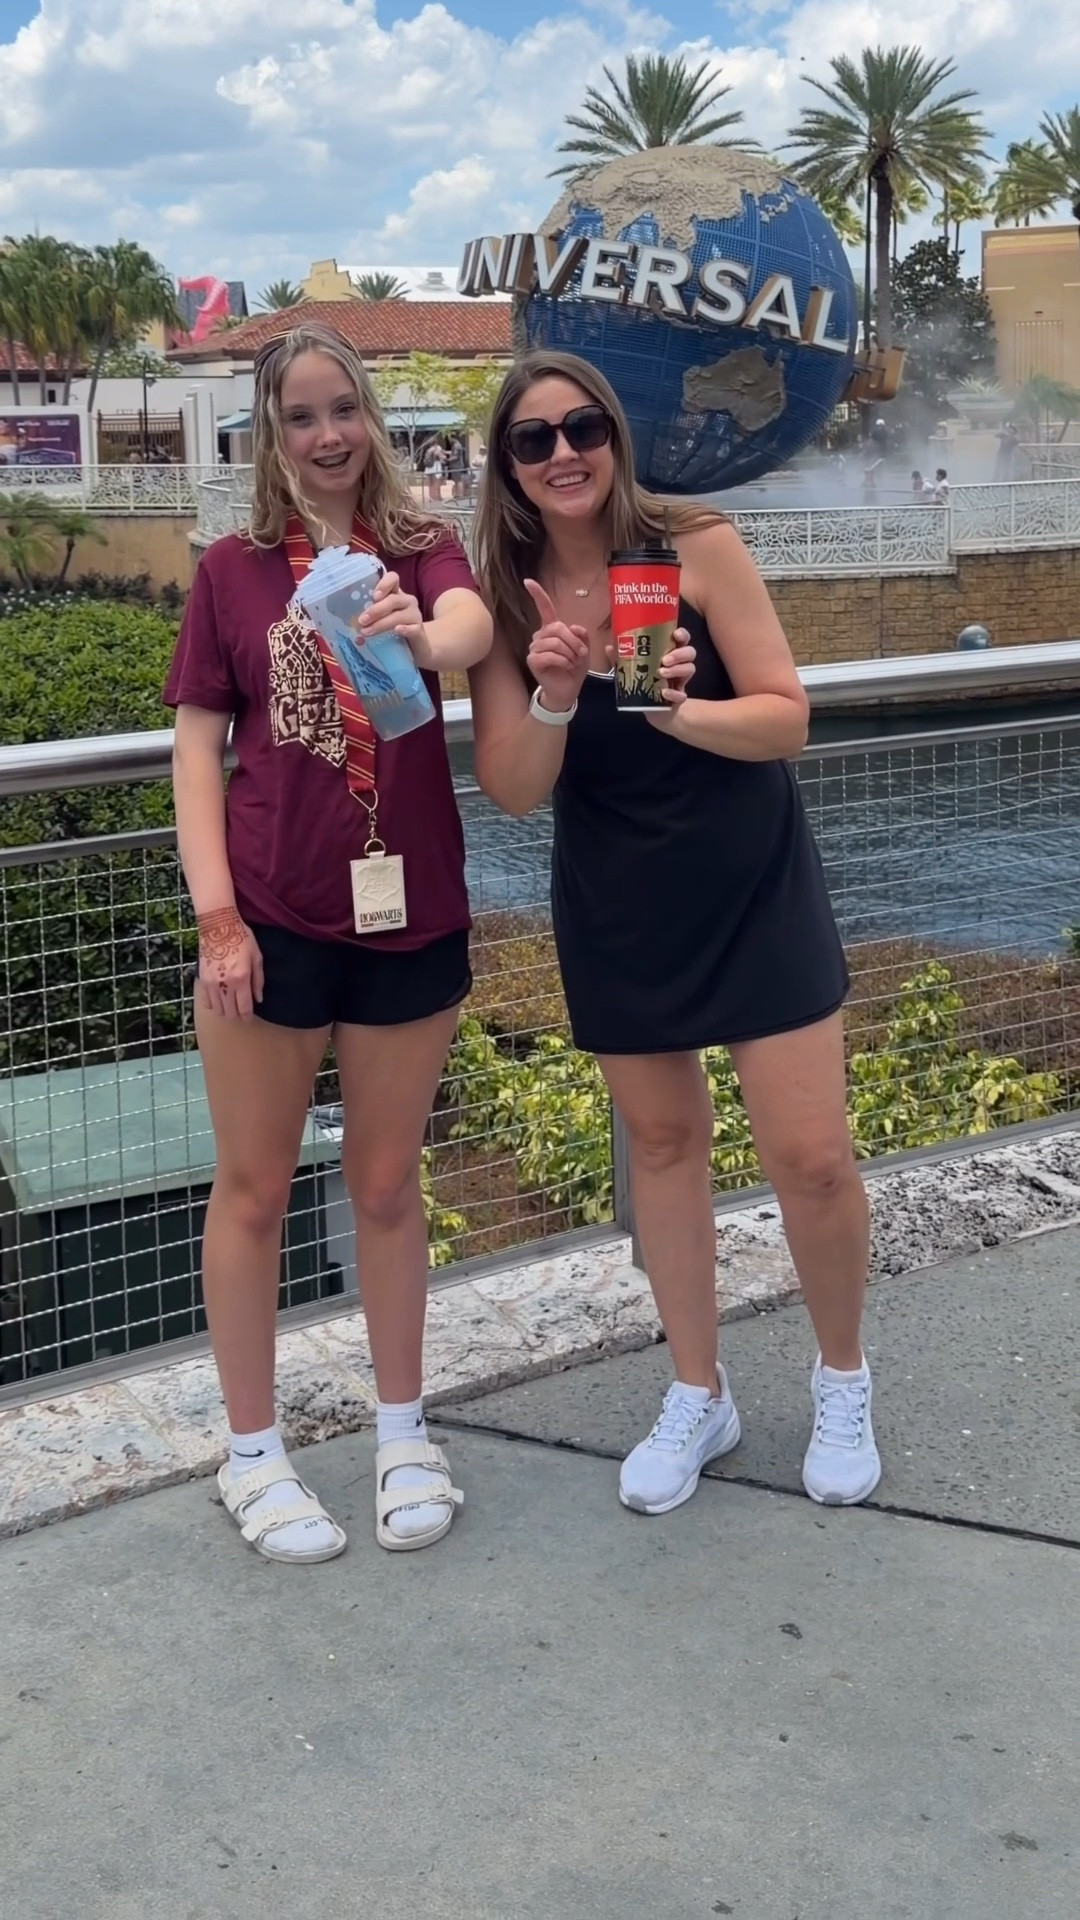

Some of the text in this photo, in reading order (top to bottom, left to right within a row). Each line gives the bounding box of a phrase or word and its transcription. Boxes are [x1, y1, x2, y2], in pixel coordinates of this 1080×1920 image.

[456, 233, 850, 353] UNIVERSAL
[614, 582, 668, 594] Drink in the
[615, 593, 677, 606] FIFA World Cup
[360, 909, 403, 923] HOGWARTS
